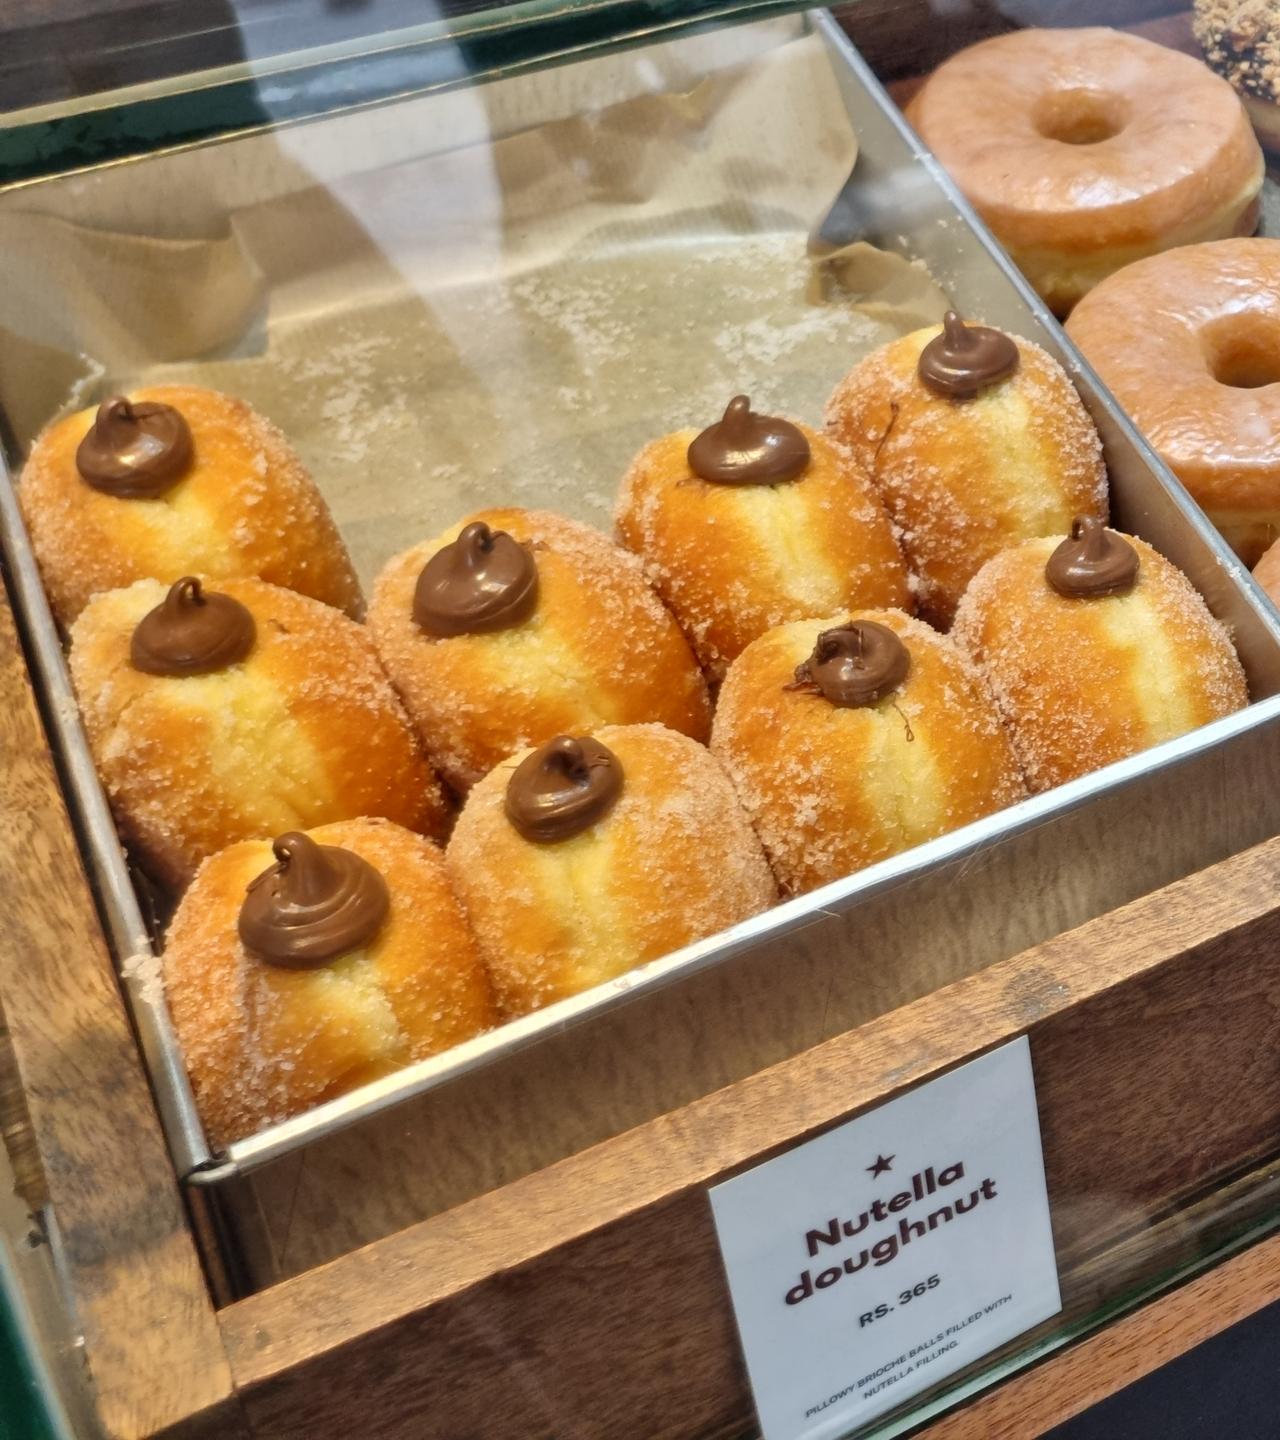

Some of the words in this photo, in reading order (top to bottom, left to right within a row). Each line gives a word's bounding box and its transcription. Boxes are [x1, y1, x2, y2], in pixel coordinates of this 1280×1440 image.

[784, 1177, 999, 1306] doughnut
[805, 1160, 965, 1258] Nutella
[859, 1302, 894, 1328] RS.
[898, 1273, 941, 1306] 365
[804, 1386, 855, 1419] PILLOWY
[857, 1355, 907, 1388] BRIOCHE
[909, 1332, 945, 1359] BALLS
[945, 1311, 983, 1338] FILLED
[983, 1293, 1013, 1317] WITH
[863, 1366, 914, 1400] NUTELLA
[916, 1339, 959, 1369] FILLING
